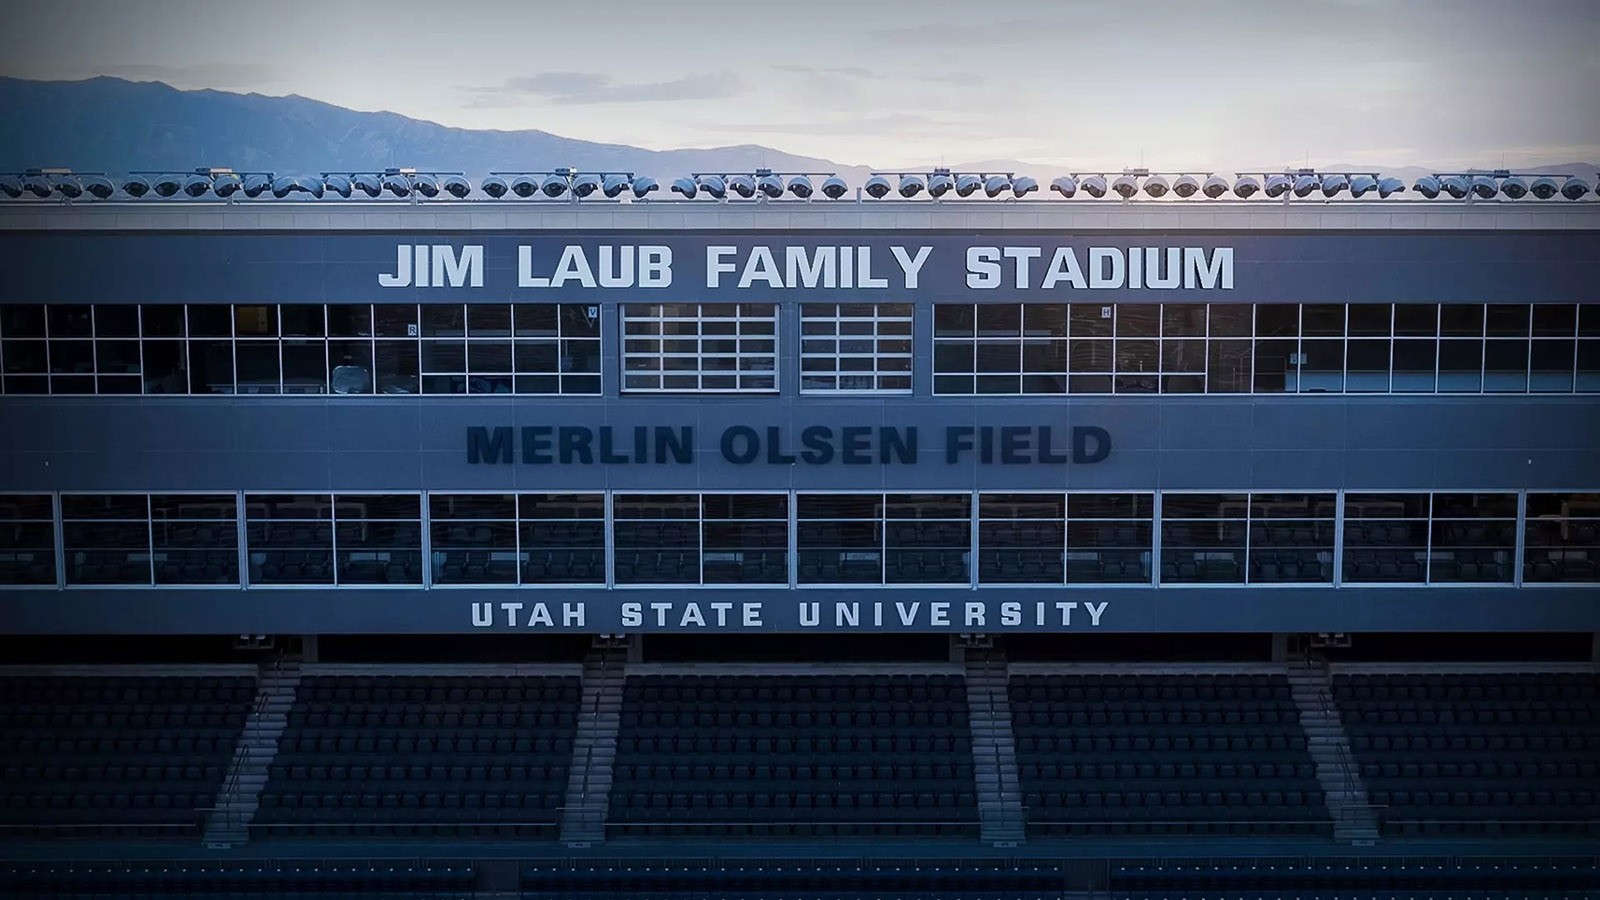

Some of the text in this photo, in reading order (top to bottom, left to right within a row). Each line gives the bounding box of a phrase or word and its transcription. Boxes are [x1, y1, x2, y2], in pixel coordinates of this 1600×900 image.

[379, 245, 1234, 290] JIM LAUB FAMILY STADIUM
[467, 426, 1111, 466] MERLIN OLSEN FIELD
[471, 601, 1109, 627] UTAH STATE UNIVERSITY
